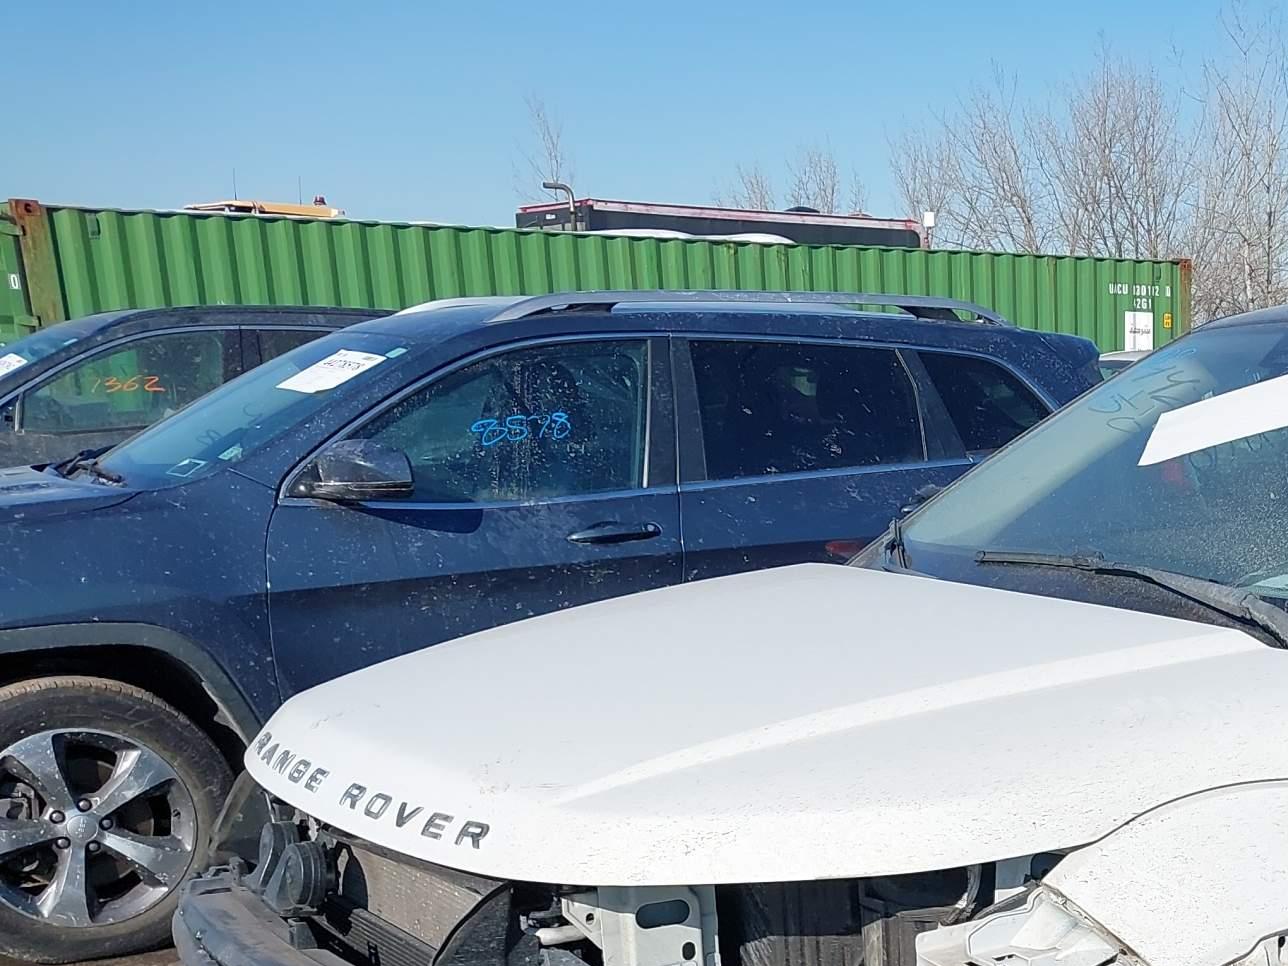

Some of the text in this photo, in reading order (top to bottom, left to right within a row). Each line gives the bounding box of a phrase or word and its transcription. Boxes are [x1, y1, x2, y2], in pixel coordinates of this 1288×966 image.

[91, 375, 165, 393] 1362
[471, 411, 571, 446] 8578
[255, 731, 490, 849] RANGE ROVER
